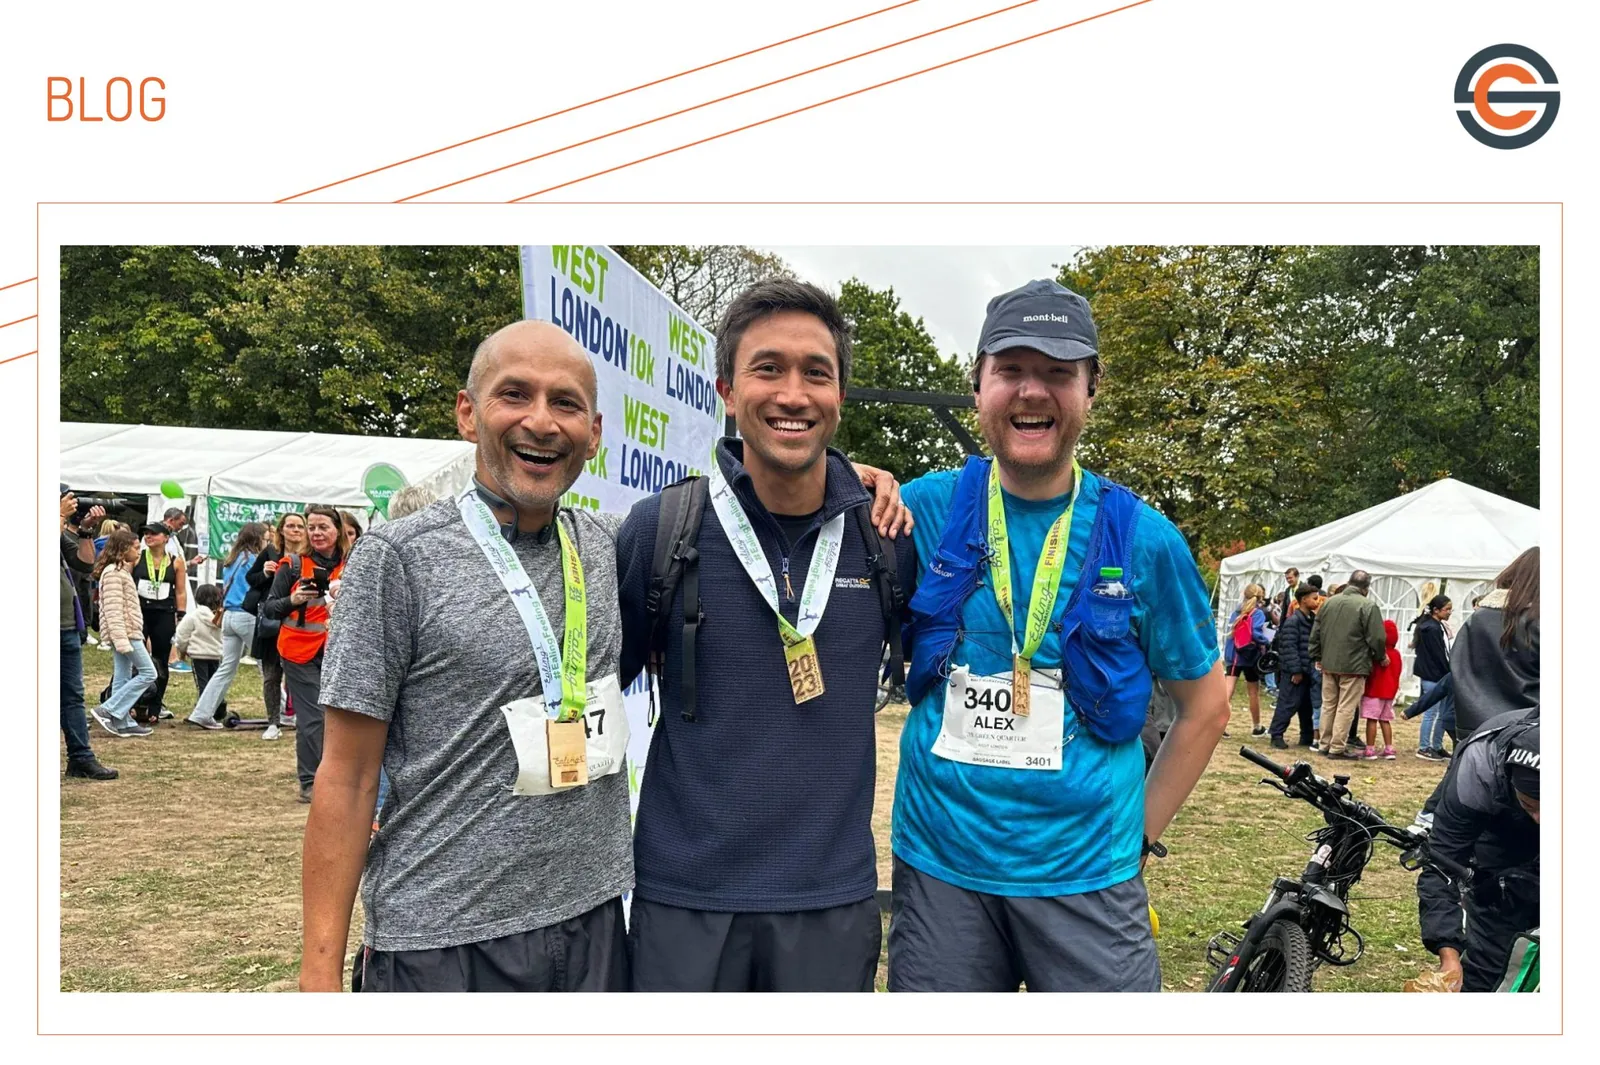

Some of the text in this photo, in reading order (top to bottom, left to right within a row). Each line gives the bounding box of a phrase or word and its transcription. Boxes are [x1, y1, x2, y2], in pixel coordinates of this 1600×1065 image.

[551, 245, 608, 303] WEST
[551, 276, 628, 371] LONDON
[668, 311, 707, 371] WEST
[666, 356, 717, 420] LONDON
[623, 394, 670, 451] WEST
[1029, 573, 1054, 645] Ealing
[565, 623, 584, 700] Ealing
[788, 654, 812, 678] 20
[793, 674, 817, 697] 23
[973, 716, 1015, 731] ALEX
[996, 735, 1027, 743] QUARTER
[1025, 756, 1051, 766] 3401
[1507, 749, 1540, 769] PUM
